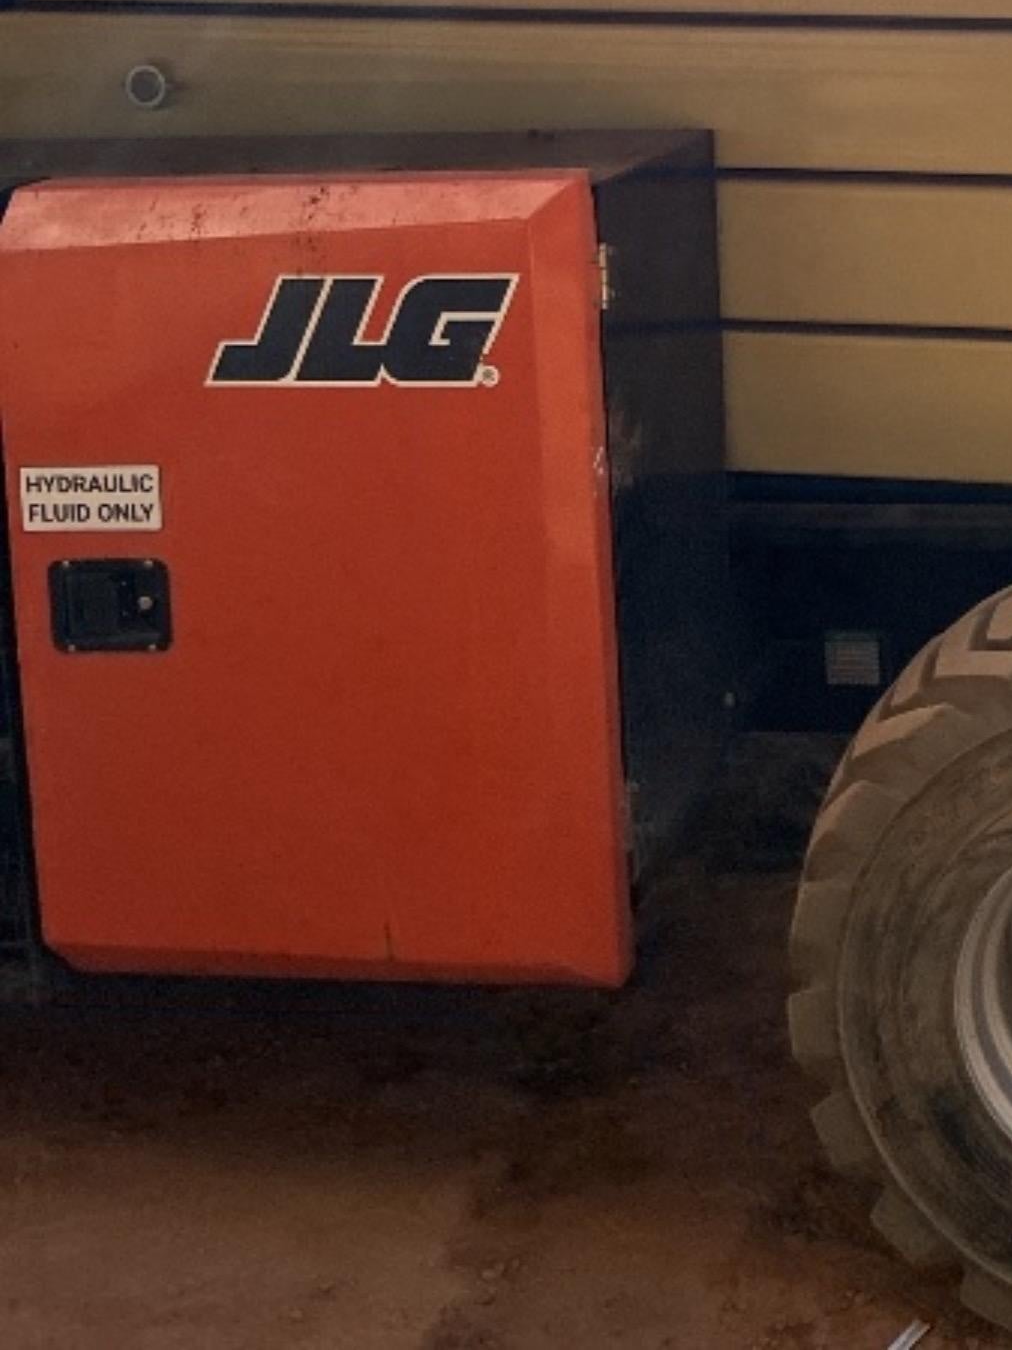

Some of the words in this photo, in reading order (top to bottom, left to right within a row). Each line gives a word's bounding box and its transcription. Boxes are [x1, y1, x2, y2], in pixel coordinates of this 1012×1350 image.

[24, 473, 154, 495] HYDRAULIC
[27, 503, 91, 524] FLUID
[97, 502, 155, 523] ONLY
